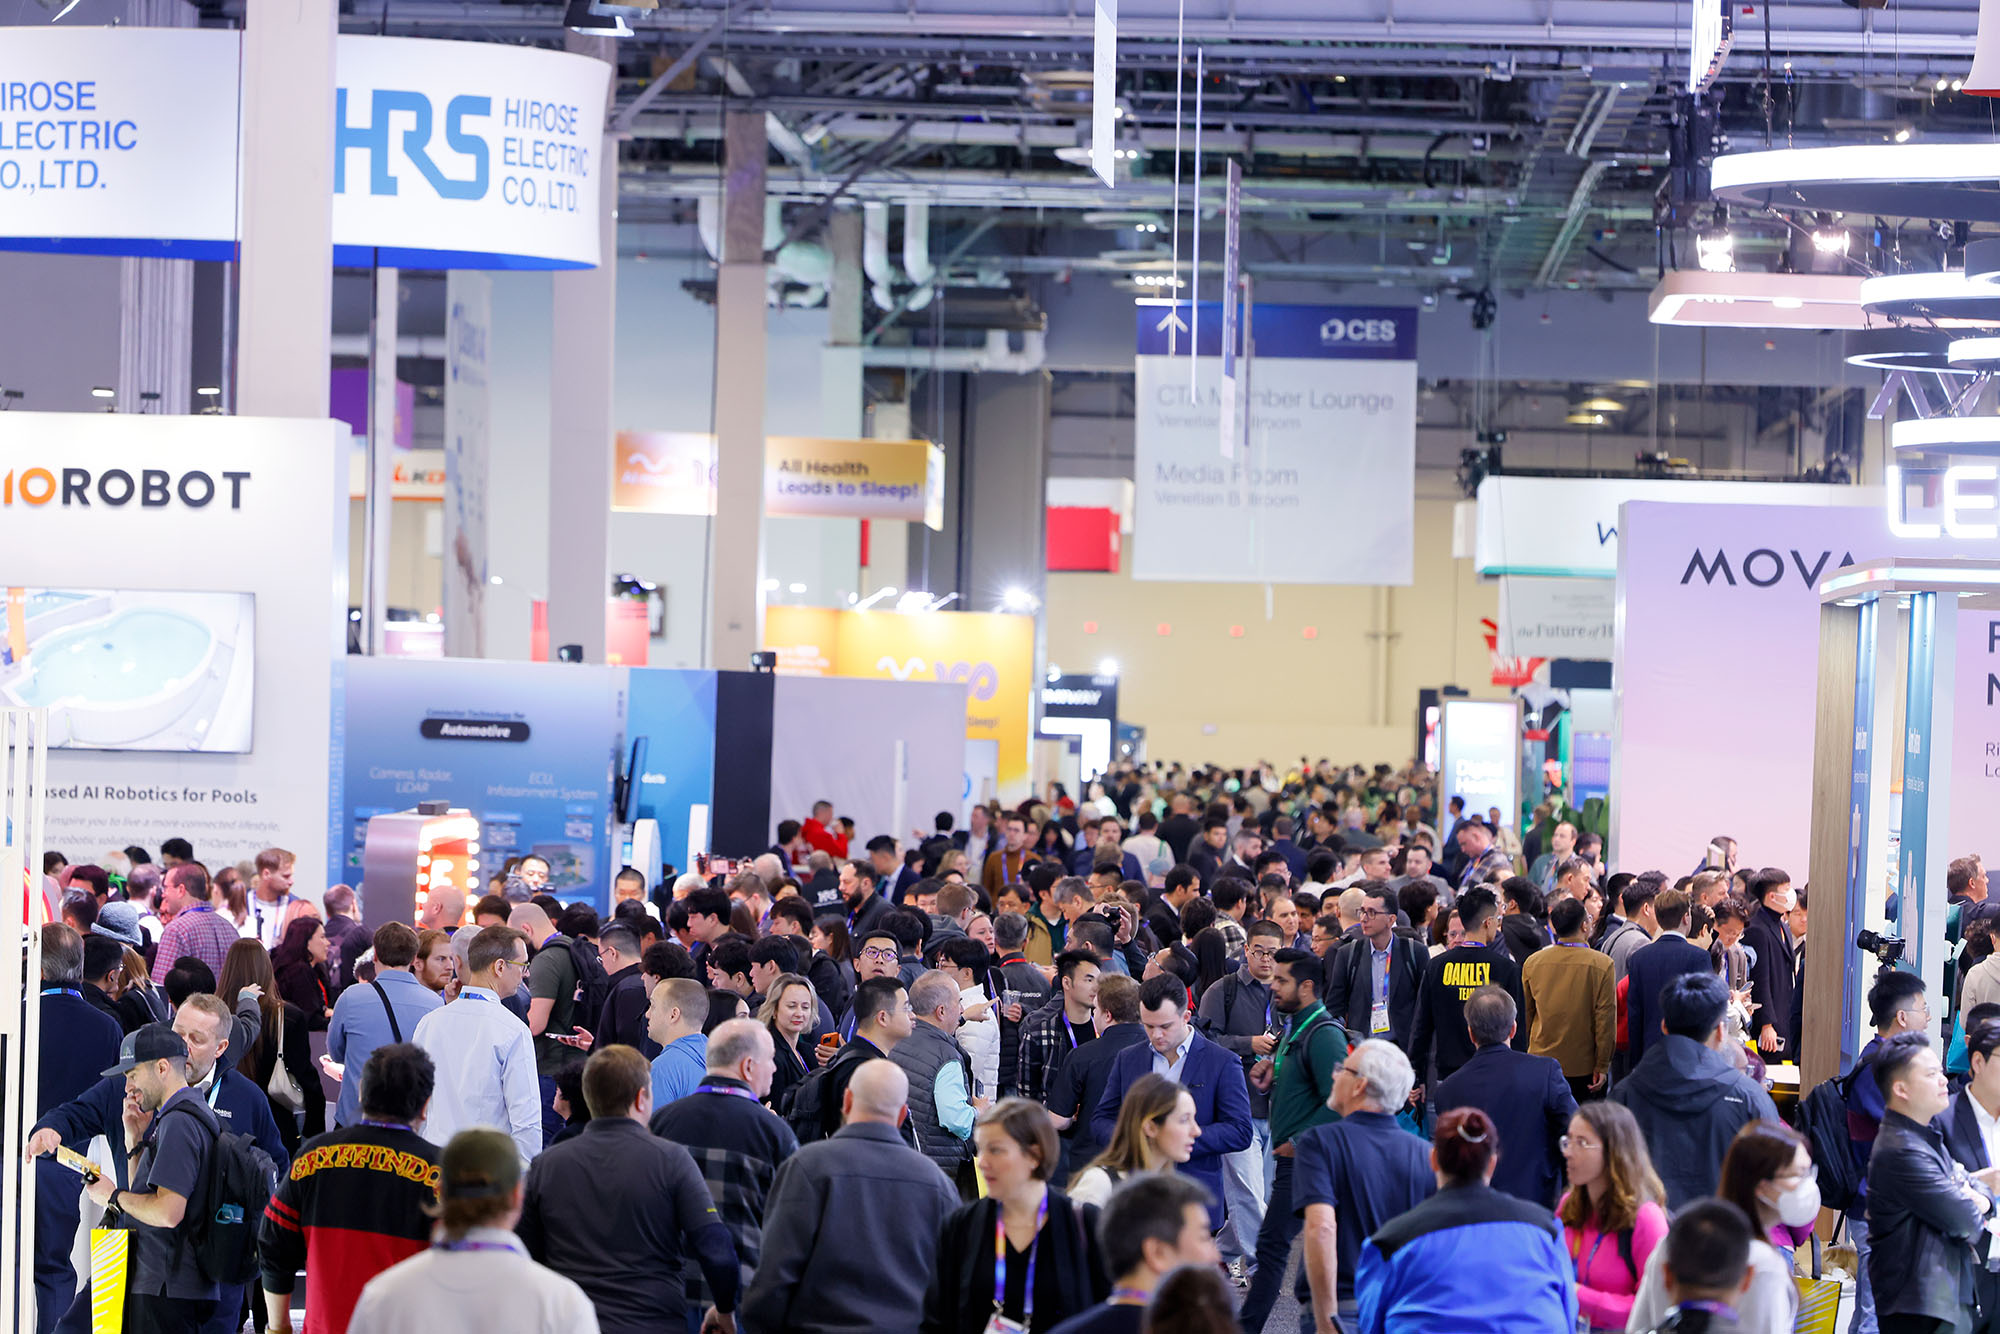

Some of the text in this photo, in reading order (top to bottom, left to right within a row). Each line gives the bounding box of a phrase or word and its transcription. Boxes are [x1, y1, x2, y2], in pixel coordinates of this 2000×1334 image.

[505, 98, 578, 136] HIROSE
[334, 88, 491, 201] HRS
[504, 137, 590, 177] ELECTRIC
[1347, 319, 1394, 341] CES
[1309, 388, 1394, 414] Lounge
[779, 459, 870, 475] All Health
[1155, 462, 1224, 484] Media
[778, 480, 918, 501] Leads to Sleep!
[1228, 491, 1299, 506] Bllroom
[1536, 623, 1587, 639] Future
[440, 722, 511, 738] Automotive
[83, 786, 99, 799] AI
[104, 786, 177, 801] Robotics
[183, 786, 206, 802] for
[212, 789, 258, 804] Pools
[560, 787, 598, 801] System
[1443, 961, 1490, 986] OAKLEY
[290, 1143, 442, 1203] GRYFFINDO
